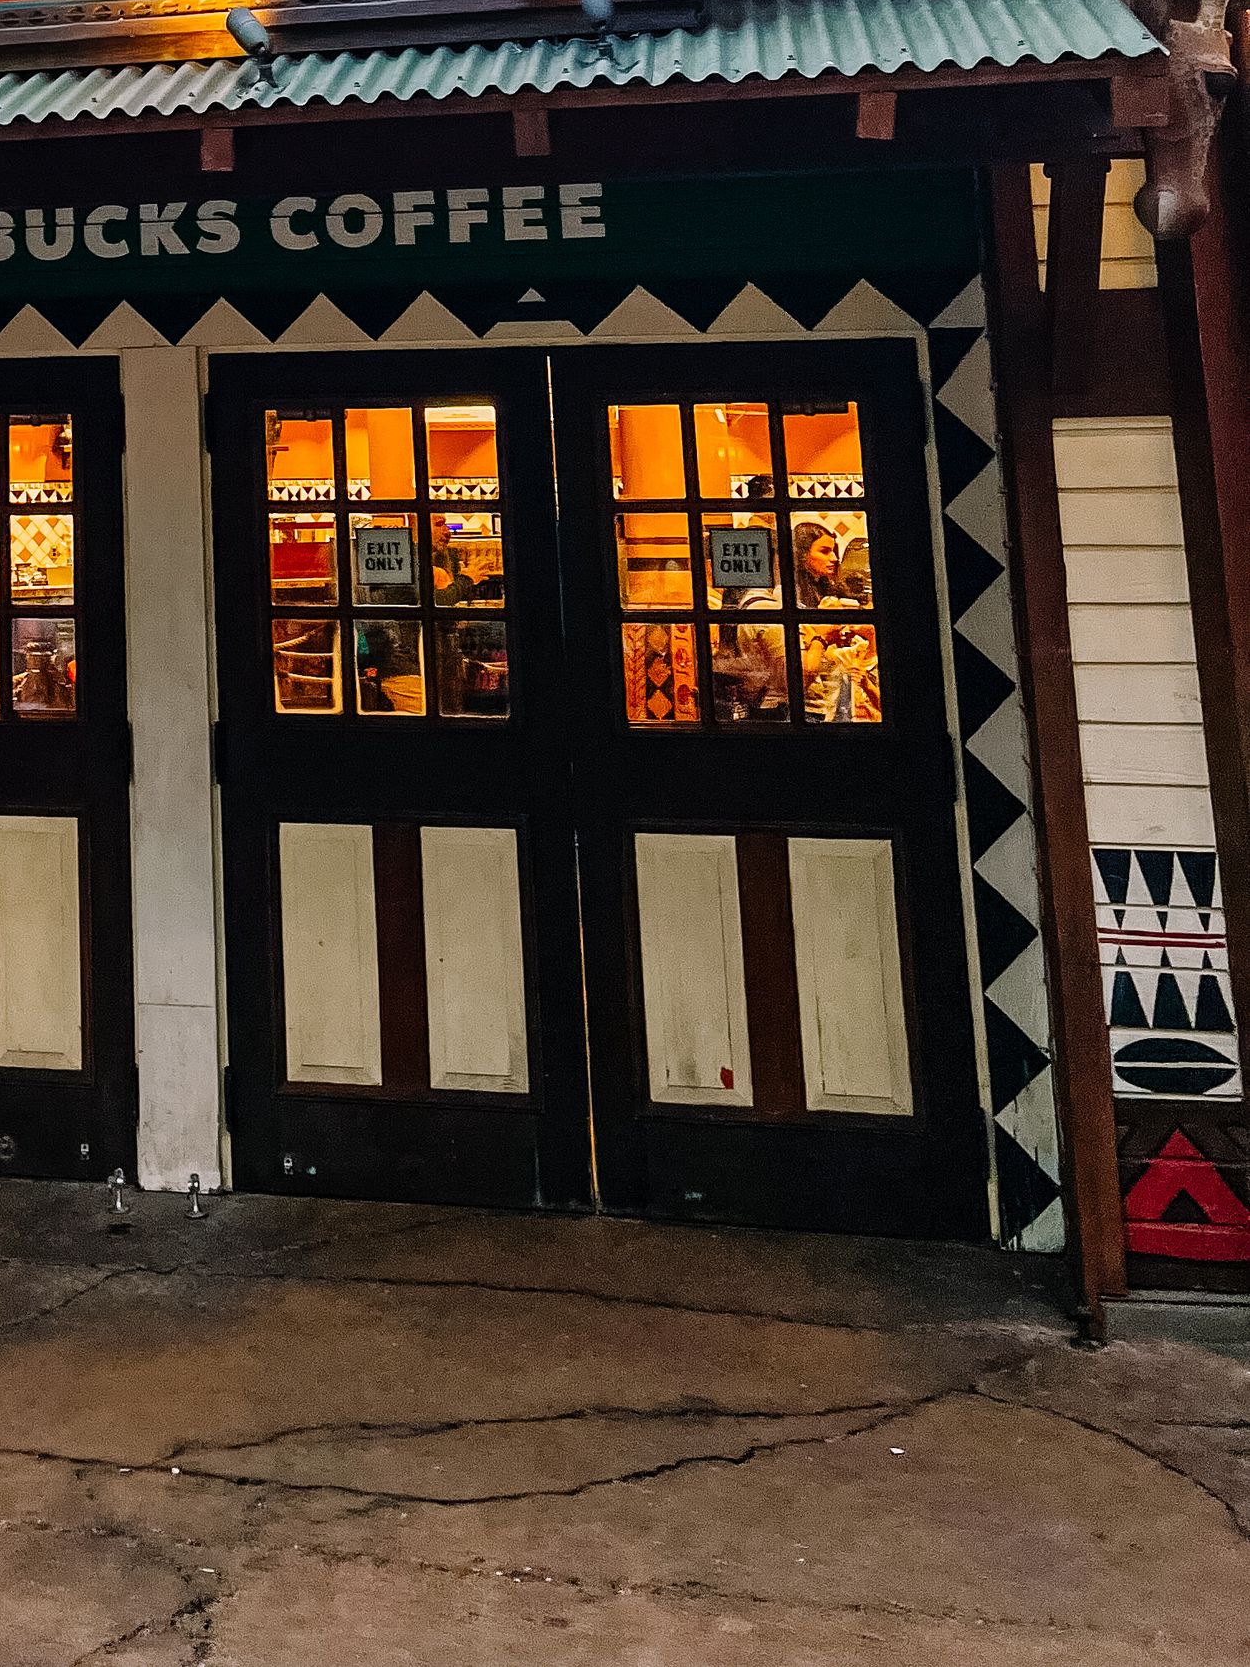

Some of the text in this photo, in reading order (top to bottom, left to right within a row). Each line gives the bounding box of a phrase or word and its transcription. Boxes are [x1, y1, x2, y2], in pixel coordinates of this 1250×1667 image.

[269, 183, 606, 250] COFFEE
[367, 542, 400, 555] EXIT
[722, 543, 760, 556] EXIT
[365, 557, 403, 571] ONLY
[720, 559, 762, 573] ONLY
